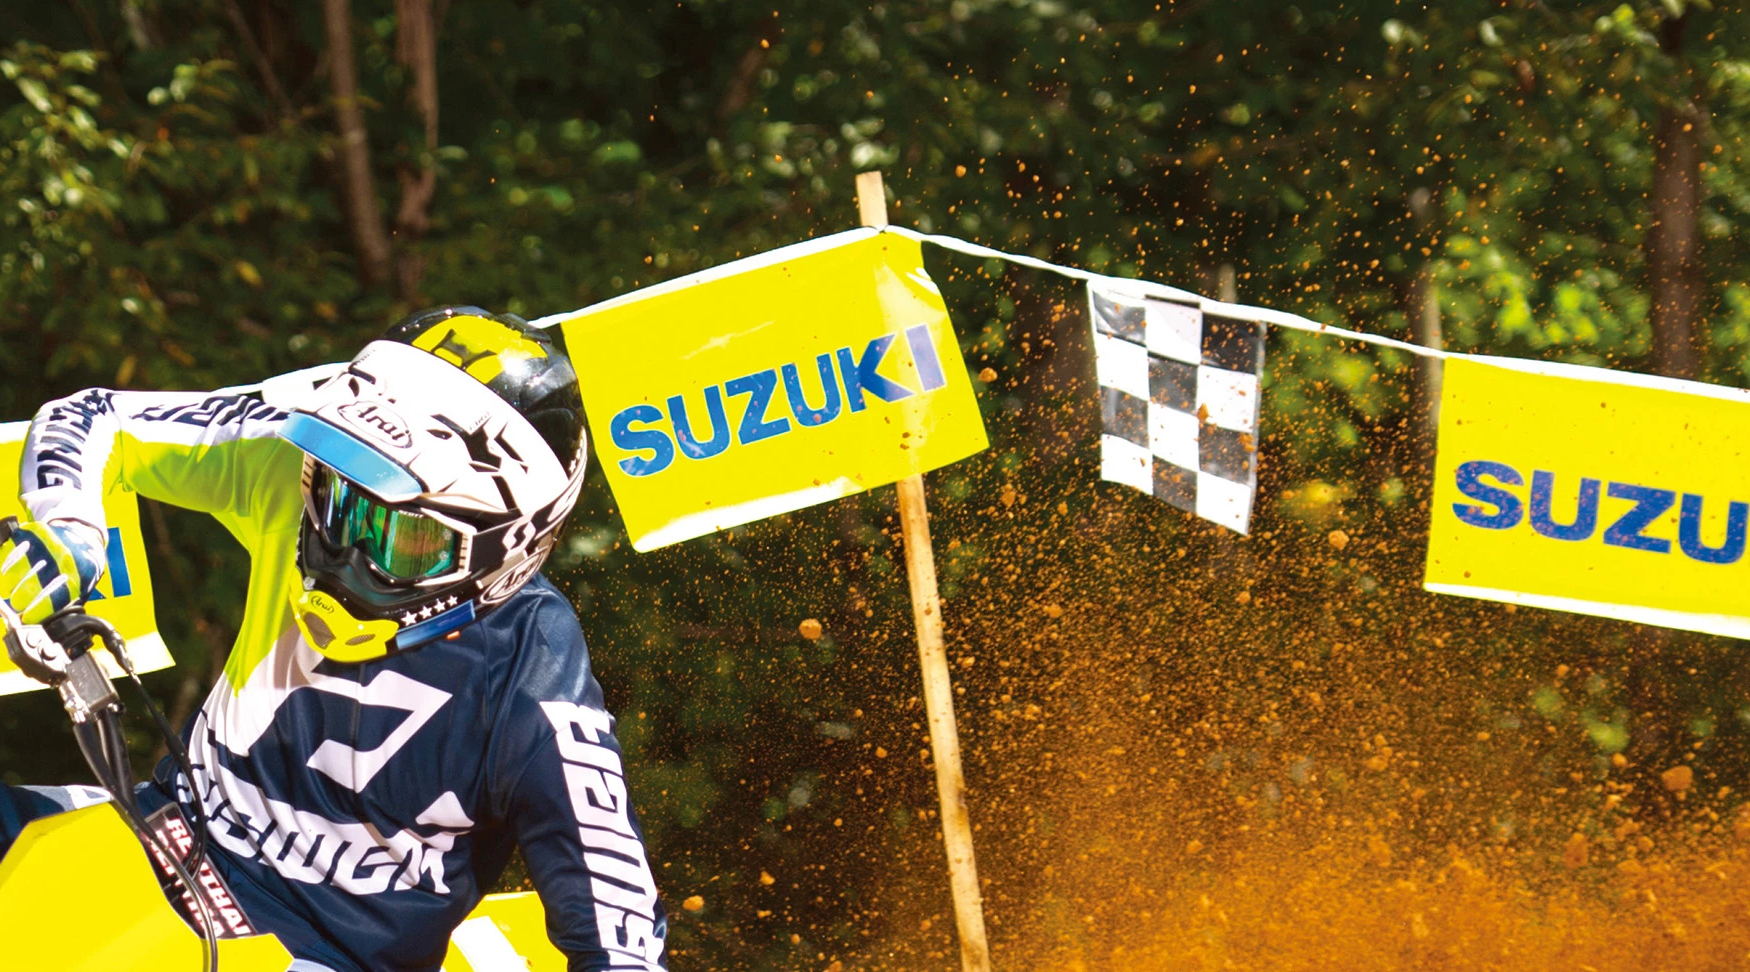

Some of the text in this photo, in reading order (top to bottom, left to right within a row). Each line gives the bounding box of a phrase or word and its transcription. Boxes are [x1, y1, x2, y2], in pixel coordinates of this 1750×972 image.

[357, 405, 410, 441] Arai
[610, 324, 948, 477] SUZUKI
[1452, 461, 1748, 564] SUZU
